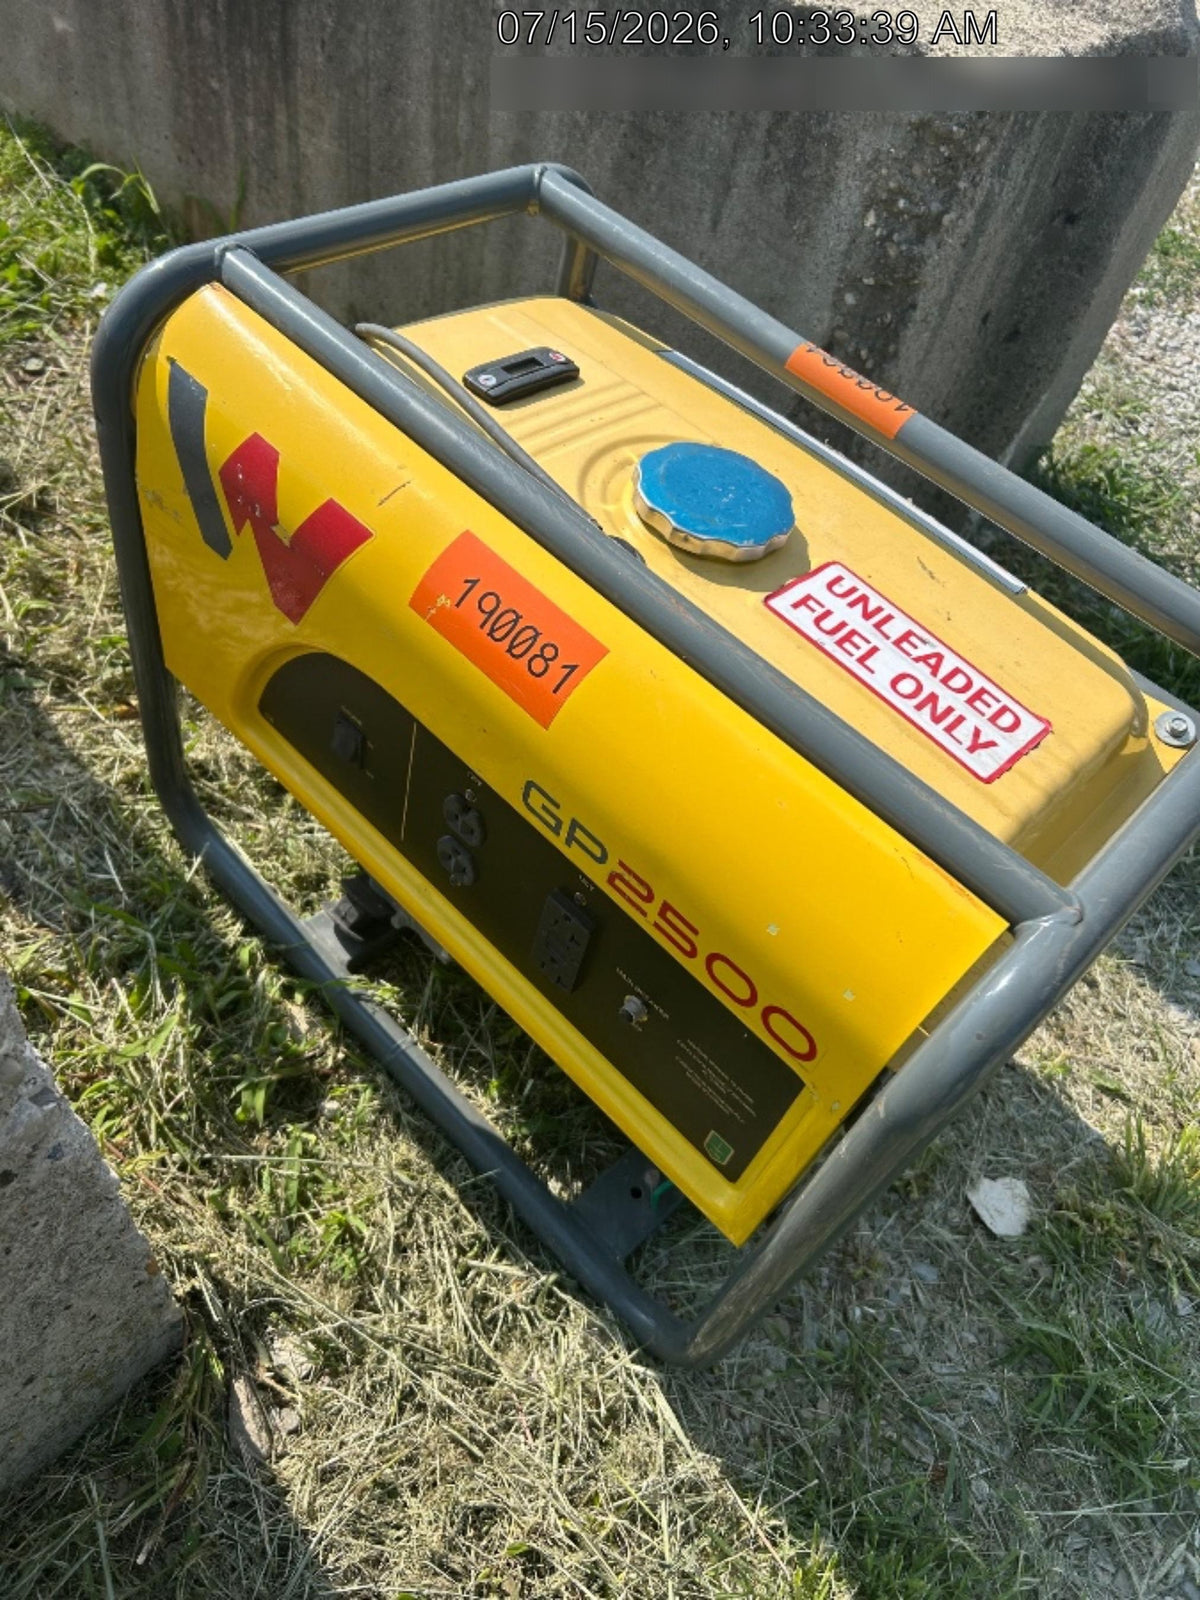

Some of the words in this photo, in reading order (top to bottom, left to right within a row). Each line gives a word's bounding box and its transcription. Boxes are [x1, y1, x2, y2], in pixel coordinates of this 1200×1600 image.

[790, 594, 883, 674] FUEL
[890, 673, 998, 755] ONLY
[826, 575, 1022, 734] UNLEADED
[522, 780, 818, 1062] GP2500
